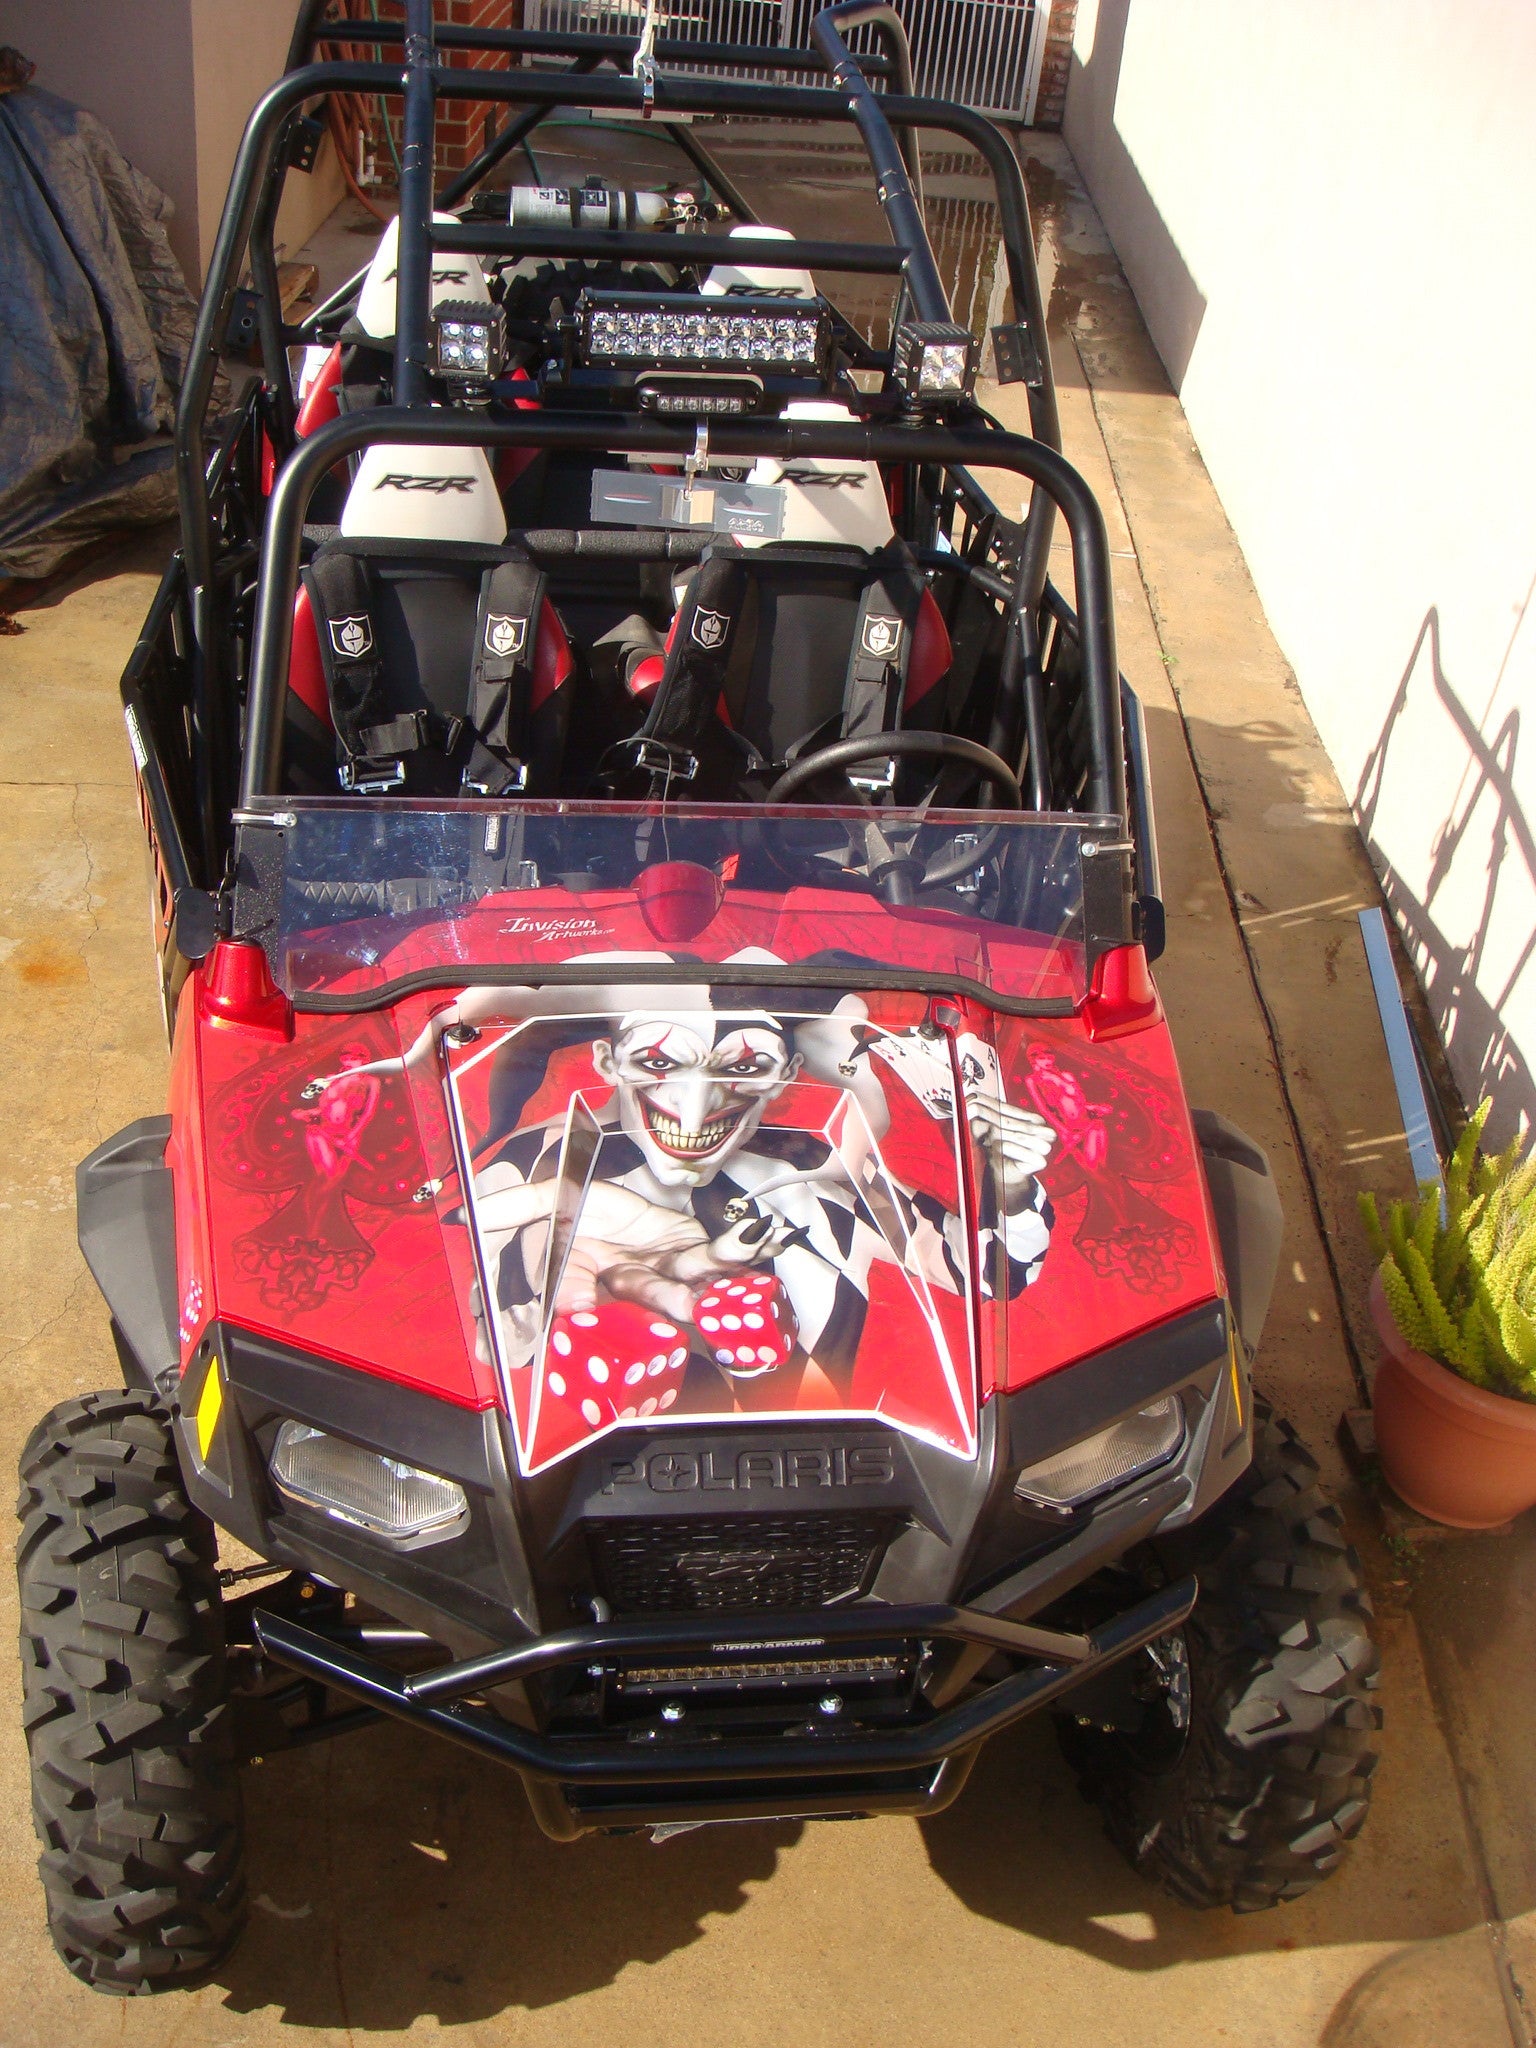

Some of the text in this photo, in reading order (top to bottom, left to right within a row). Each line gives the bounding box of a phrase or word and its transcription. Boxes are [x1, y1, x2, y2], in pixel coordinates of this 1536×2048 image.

[726, 284, 804, 299] RZR
[374, 473, 478, 494] RZR
[773, 469, 868, 489] RZR
[499, 917, 597, 934] Invision
[600, 1446, 895, 1496] POLARIS
